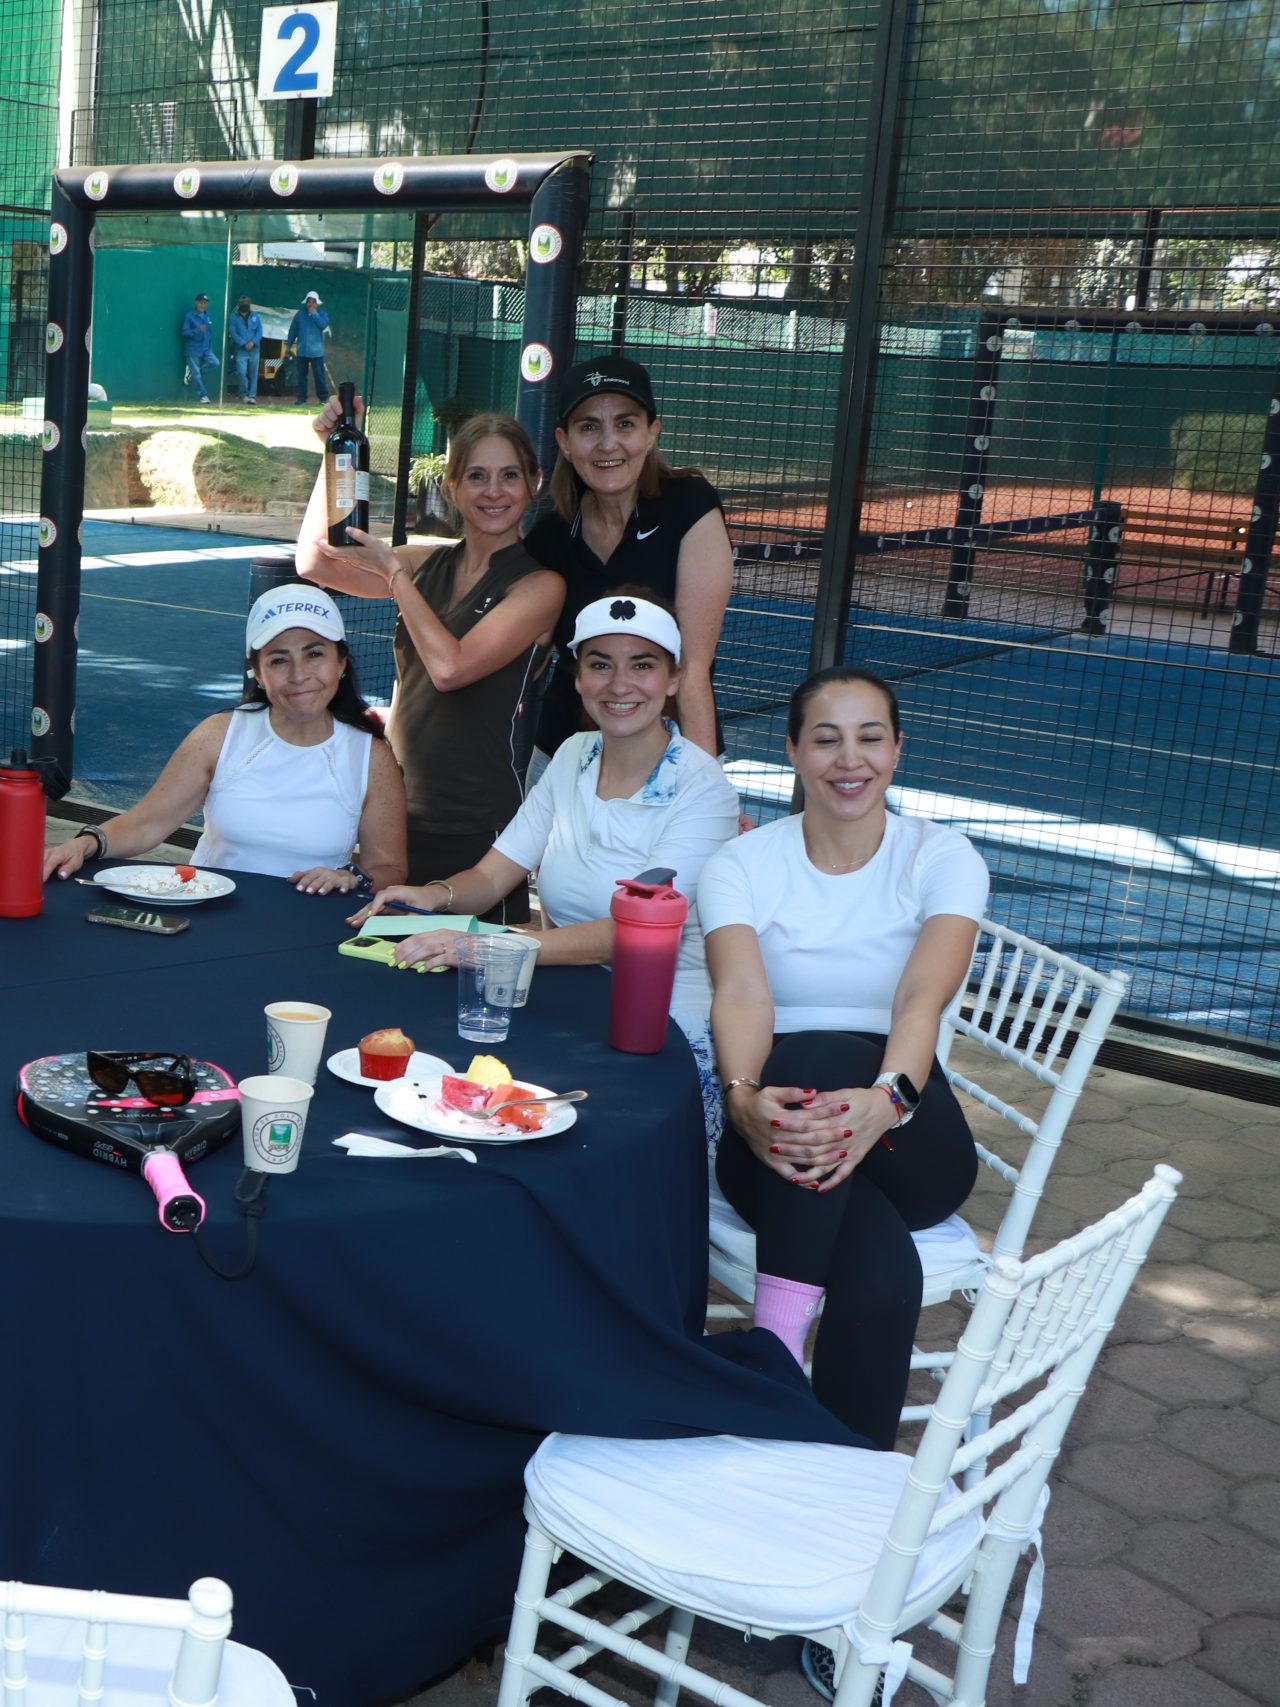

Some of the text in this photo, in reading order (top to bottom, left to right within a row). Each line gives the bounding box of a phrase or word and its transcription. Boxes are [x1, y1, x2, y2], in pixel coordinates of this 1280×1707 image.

[272, 12, 320, 93] 2
[276, 602, 330, 619] TERREX
[92, 1148, 128, 1168] HYBRID
[184, 1139, 208, 1160] HYBRID
